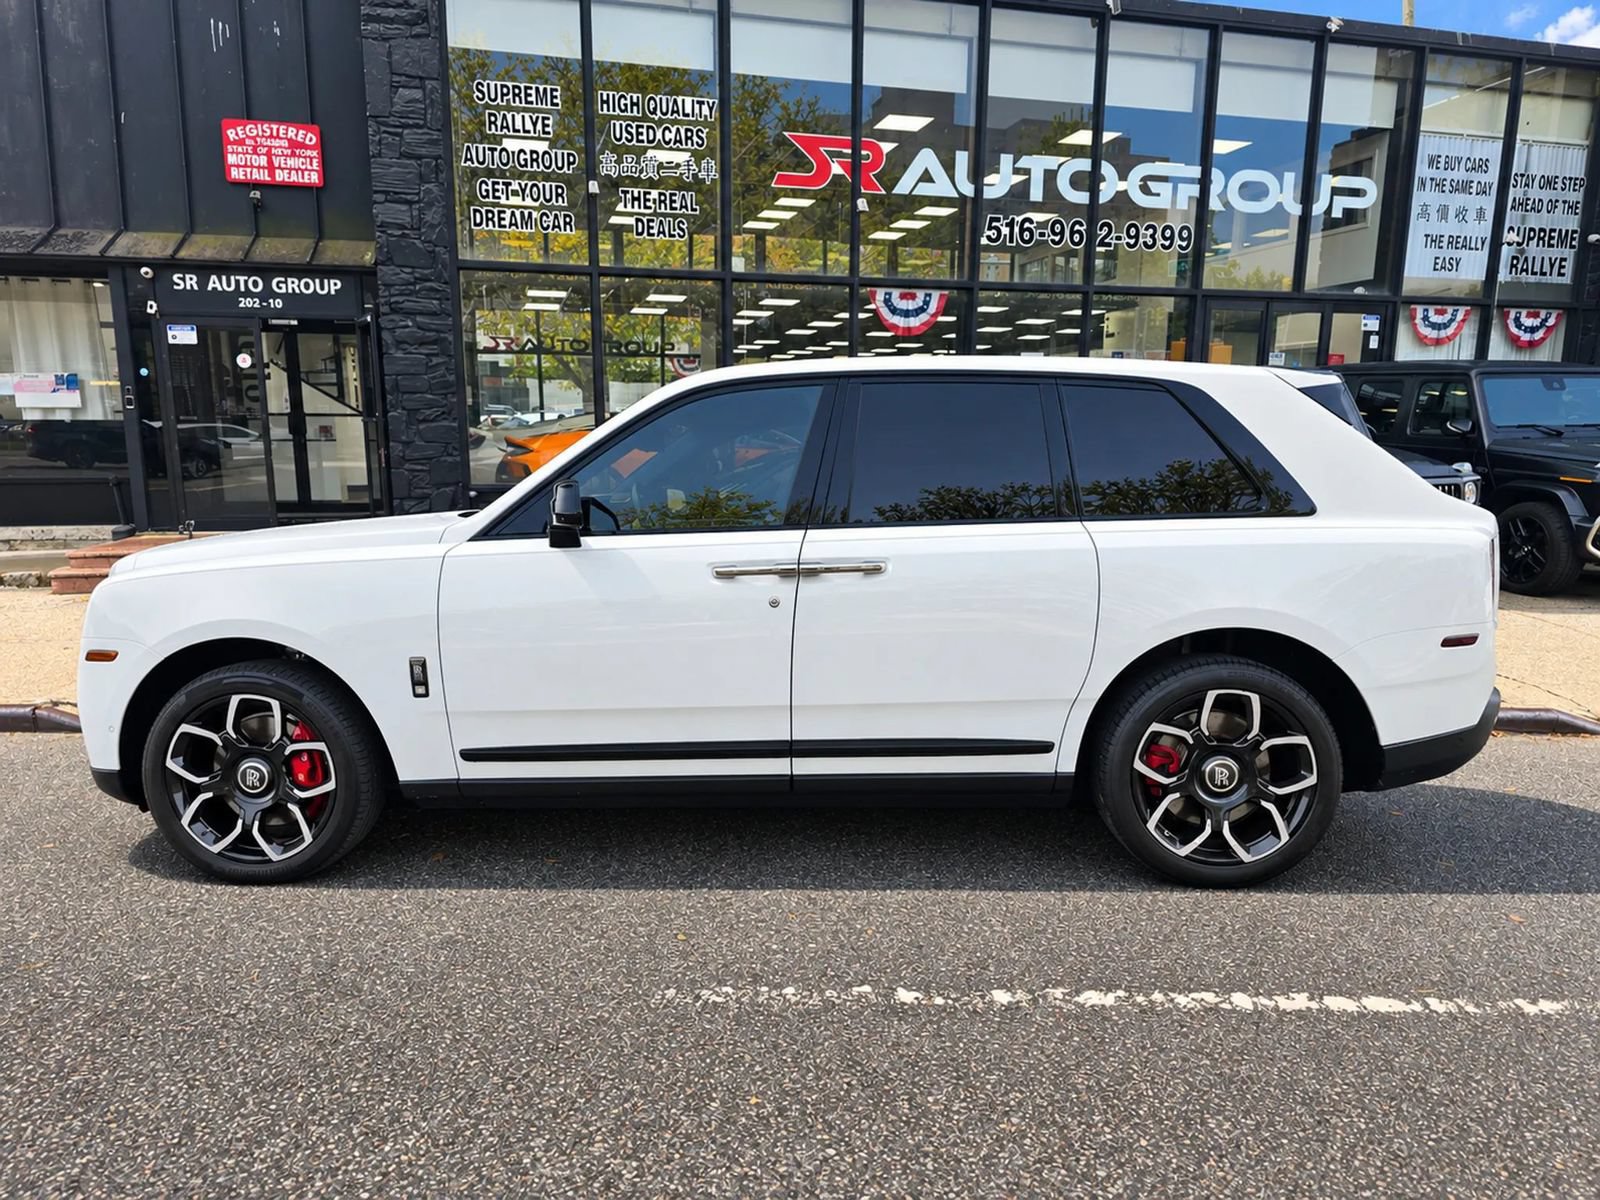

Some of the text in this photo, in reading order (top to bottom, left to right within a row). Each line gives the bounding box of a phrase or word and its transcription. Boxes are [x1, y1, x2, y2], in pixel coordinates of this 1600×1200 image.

[474, 80, 561, 109] SUPREME
[599, 91, 717, 121] HIGH QUALITY
[226, 123, 317, 145] REGISTERED
[486, 110, 552, 136] RALLYE
[611, 120, 707, 149] USED CARS
[227, 145, 319, 157] STATE OF NEW YORK
[227, 153, 319, 170] MOTOR VEHICLE
[462, 143, 578, 173] AUTO GROUP
[771, 131, 886, 194] SR
[1427, 153, 1490, 174] WE BUY CARS
[230, 167, 319, 183] RETAIL DEALER
[1512, 172, 1586, 193] STAY ONE STEP
[477, 179, 567, 206] GET YOUR
[1416, 176, 1494, 197] IN THE SAME DAY
[619, 188, 699, 214] THE REAL
[1510, 197, 1581, 216] AHEAD OF THE
[470, 207, 575, 233] DREAM CAR
[1416, 202, 1488, 225] 高價收車
[634, 216, 688, 240] DEALS
[985, 214, 1194, 253] 516-962-9399
[1423, 234, 1488, 252] THE REALLY
[1433, 256, 1462, 272] EASY
[1509, 255, 1568, 277] RALLYE
[172, 273, 342, 295] SR AUTO GROUP
[238, 297, 283, 308] 202-10
